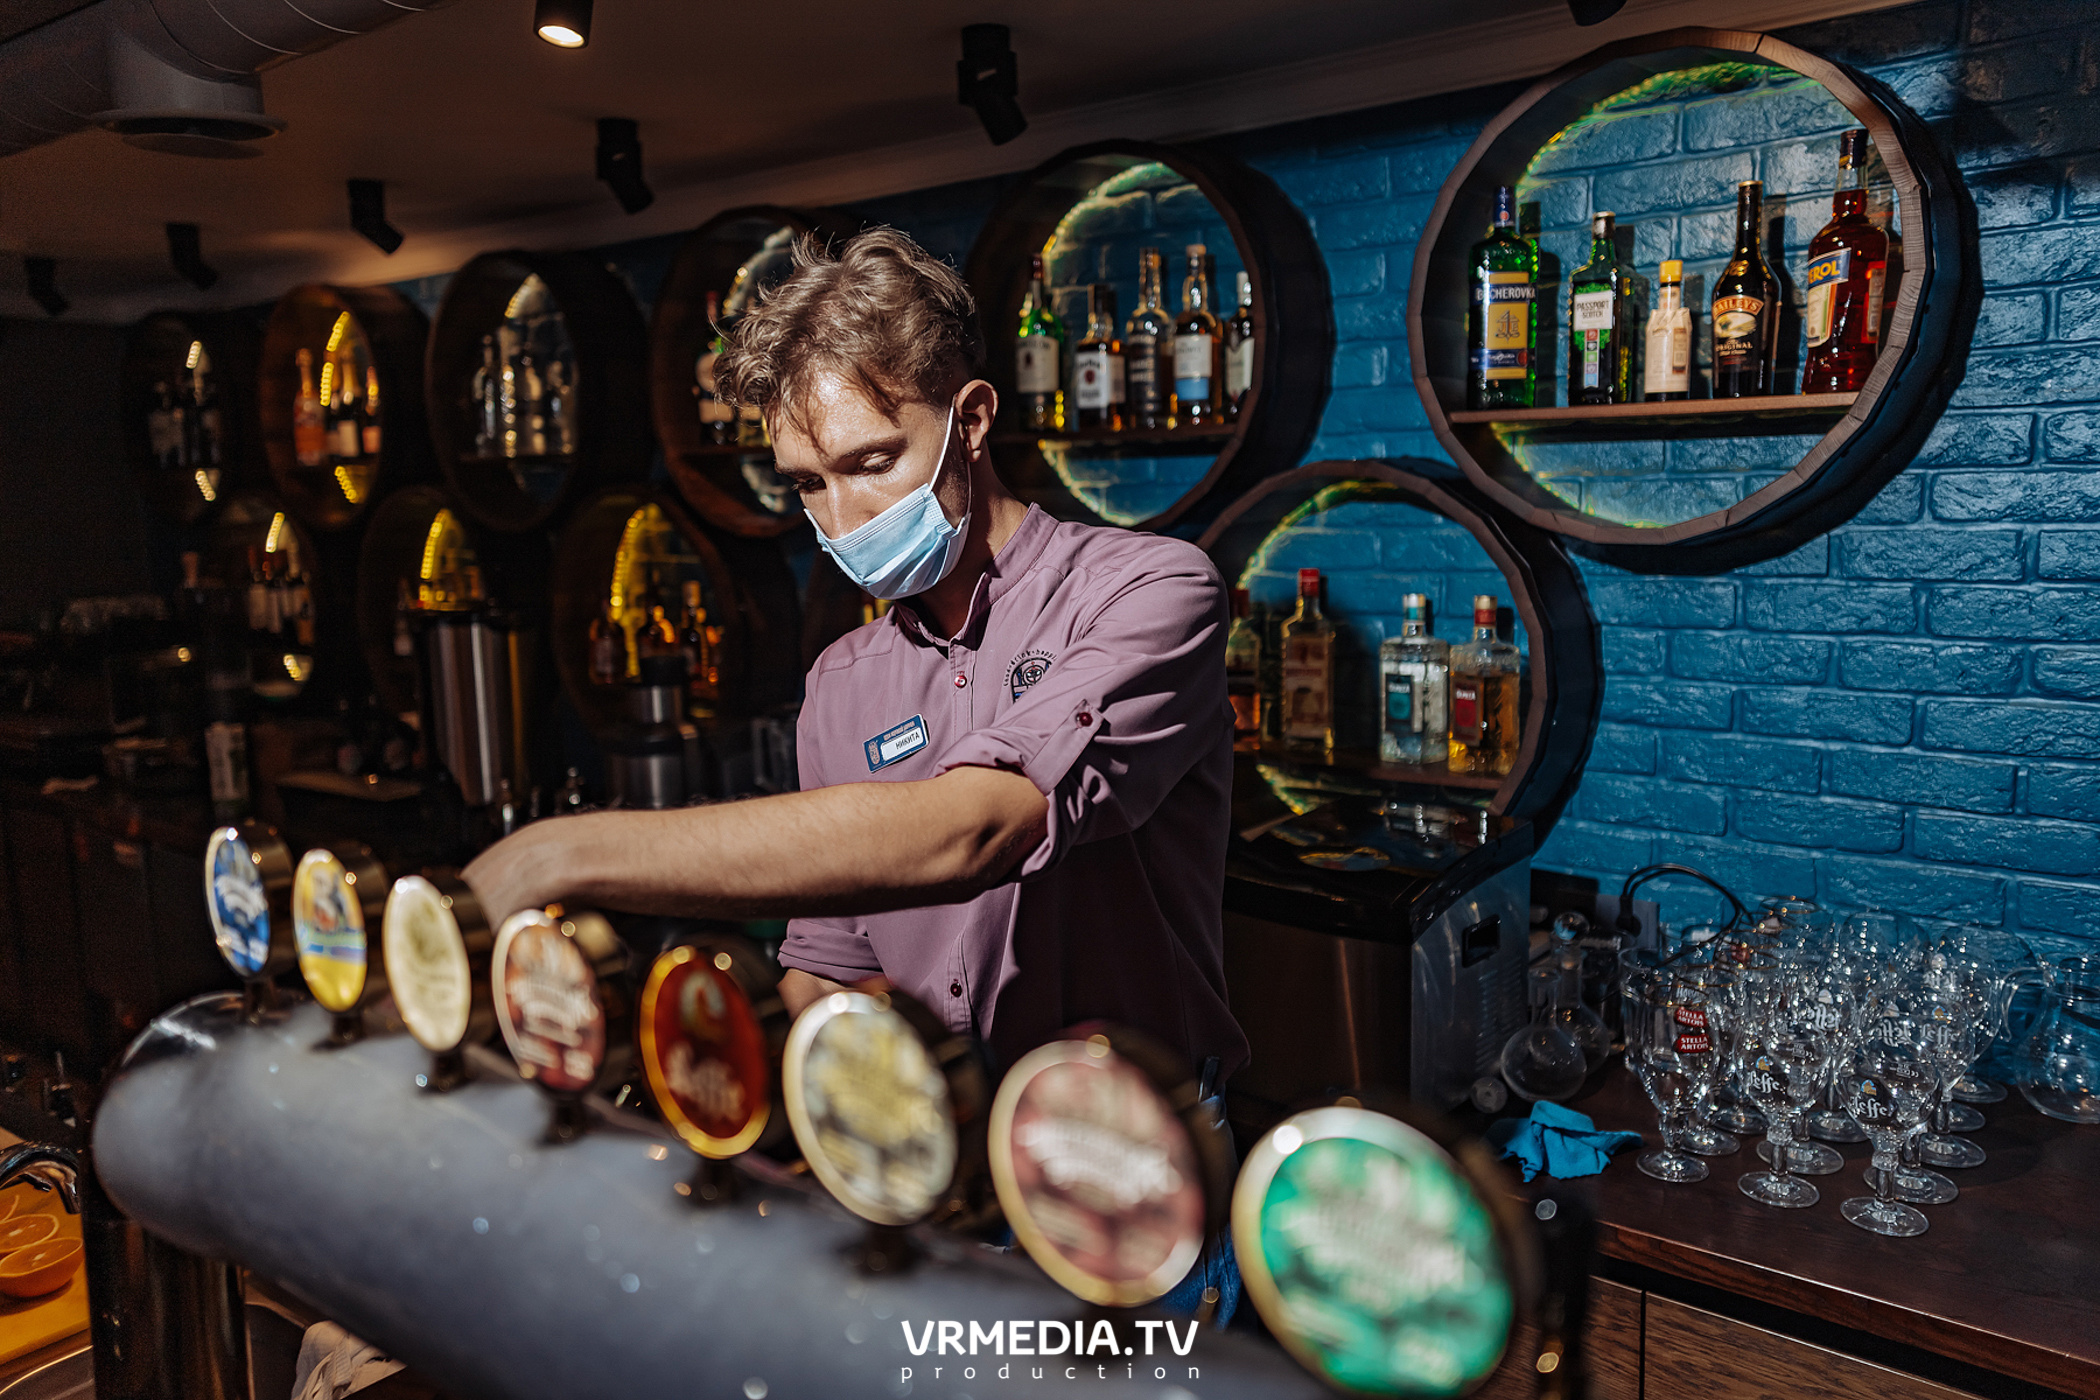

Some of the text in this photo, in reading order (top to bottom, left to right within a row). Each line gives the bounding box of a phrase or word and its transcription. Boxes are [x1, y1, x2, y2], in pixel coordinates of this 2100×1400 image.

[1577, 300, 1609, 310] PASSPORT
[895, 732, 920, 750] НИКИТА
[1677, 1009, 1703, 1020] STELLA
[1677, 1016, 1704, 1026] ARTOIS
[1681, 1036, 1707, 1044] STELLA
[1921, 1023, 1960, 1045] Leffe
[1748, 1070, 1780, 1093] Leffe
[1851, 1092, 1888, 1118] Leffe
